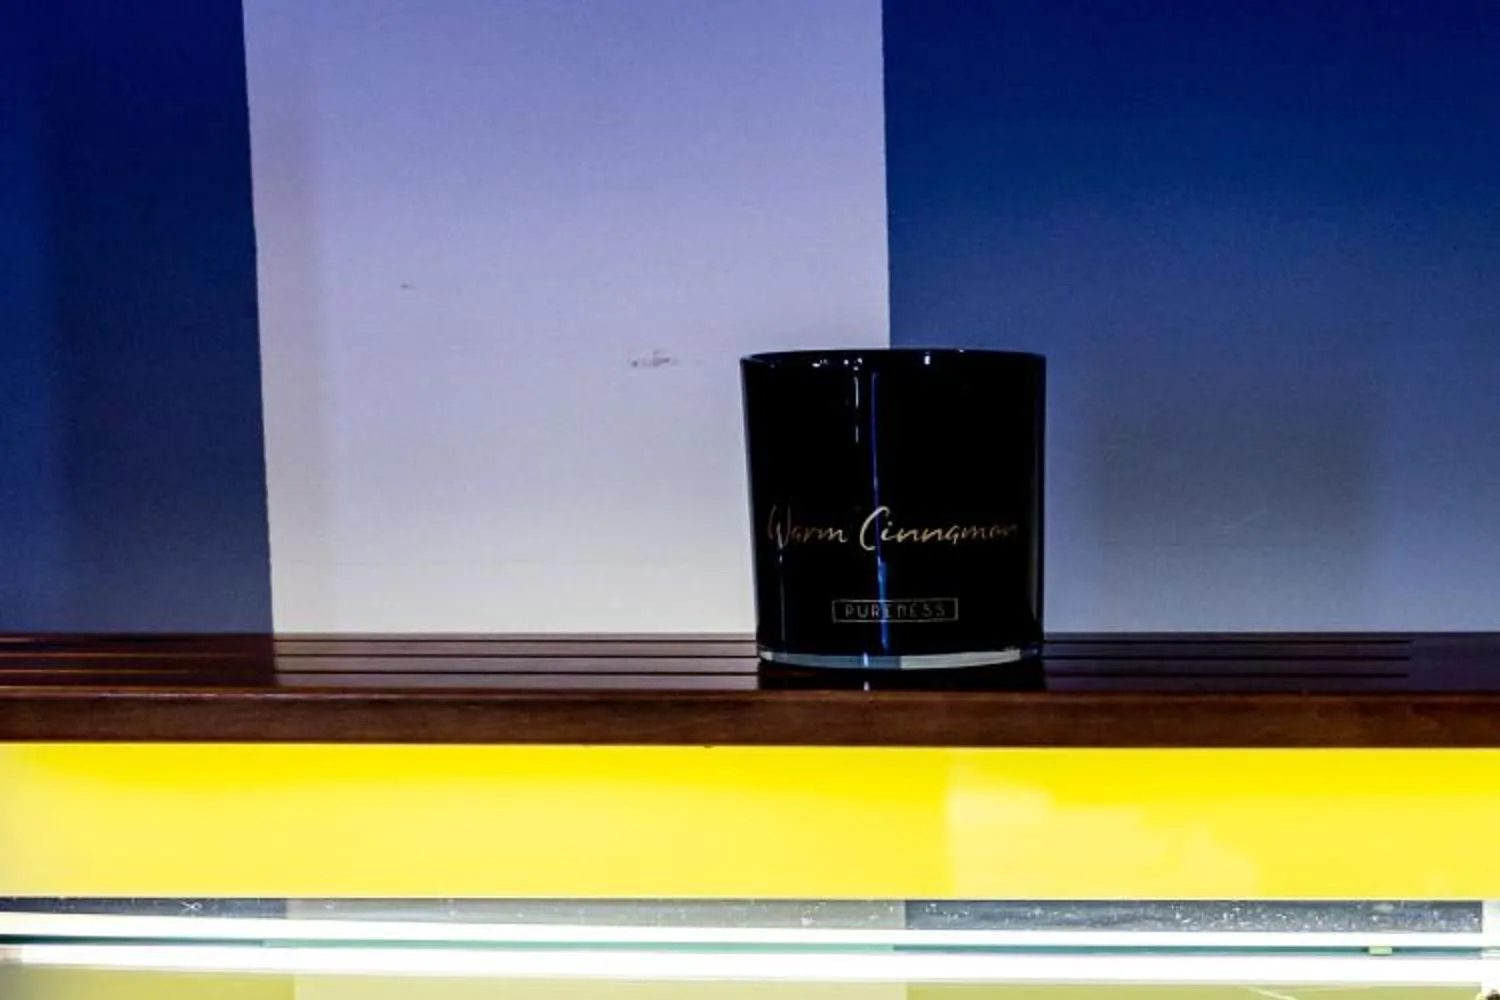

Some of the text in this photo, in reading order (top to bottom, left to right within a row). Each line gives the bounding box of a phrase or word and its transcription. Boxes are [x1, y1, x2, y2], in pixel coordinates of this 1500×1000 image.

[766, 503, 1019, 551] Warm Cinnamon
[844, 602, 946, 619] PURENESS
